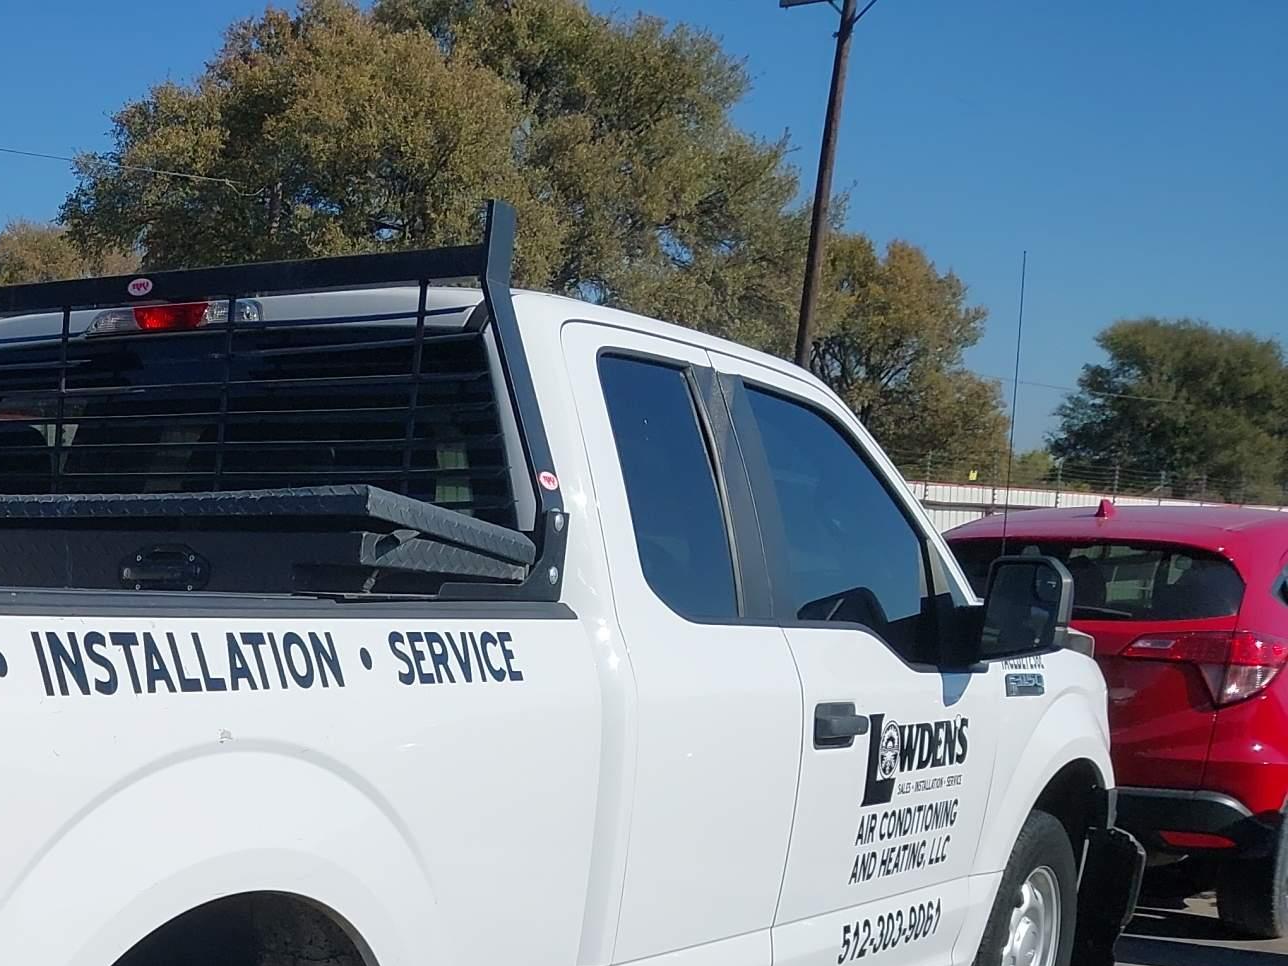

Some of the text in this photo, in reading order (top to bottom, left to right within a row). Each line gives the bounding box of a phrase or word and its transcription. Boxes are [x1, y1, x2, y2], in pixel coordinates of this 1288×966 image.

[30, 630, 346, 697] INSTALLATION
[388, 630, 525, 686] SERVICE
[897, 774, 963, 795] SALES INSTALLATION SERVICE
[855, 798, 959, 846] AIR CONDITIONING
[848, 834, 951, 885] AND HEATING, LLC
[837, 897, 941, 965] 512-303-9061
